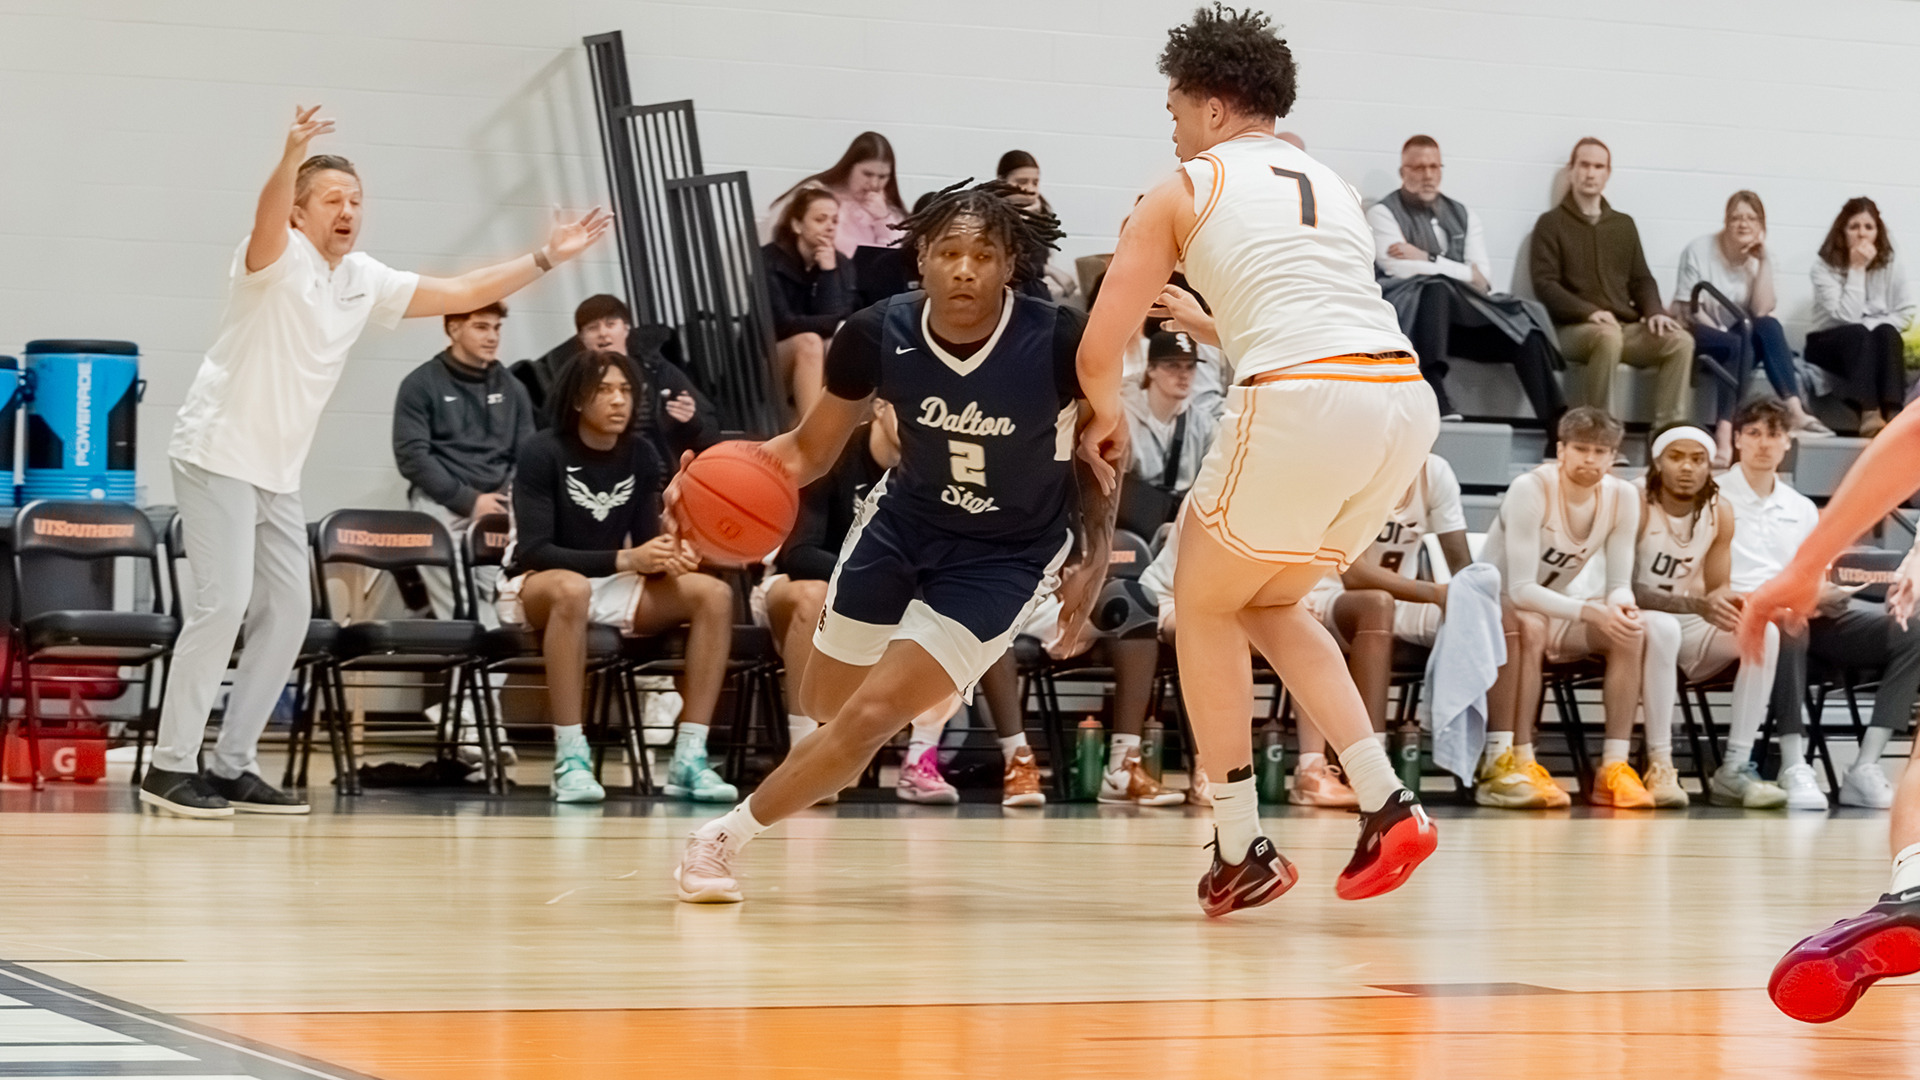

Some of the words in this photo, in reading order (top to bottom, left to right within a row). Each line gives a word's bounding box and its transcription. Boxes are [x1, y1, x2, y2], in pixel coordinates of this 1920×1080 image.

[1268, 165, 1318, 229] 7
[75, 362, 92, 467] POWERADE
[916, 396, 1016, 436] Dalton
[947, 439, 987, 487] 2
[53, 746, 77, 774] G
[1266, 744, 1283, 763] G
[1402, 744, 1418, 762] G
